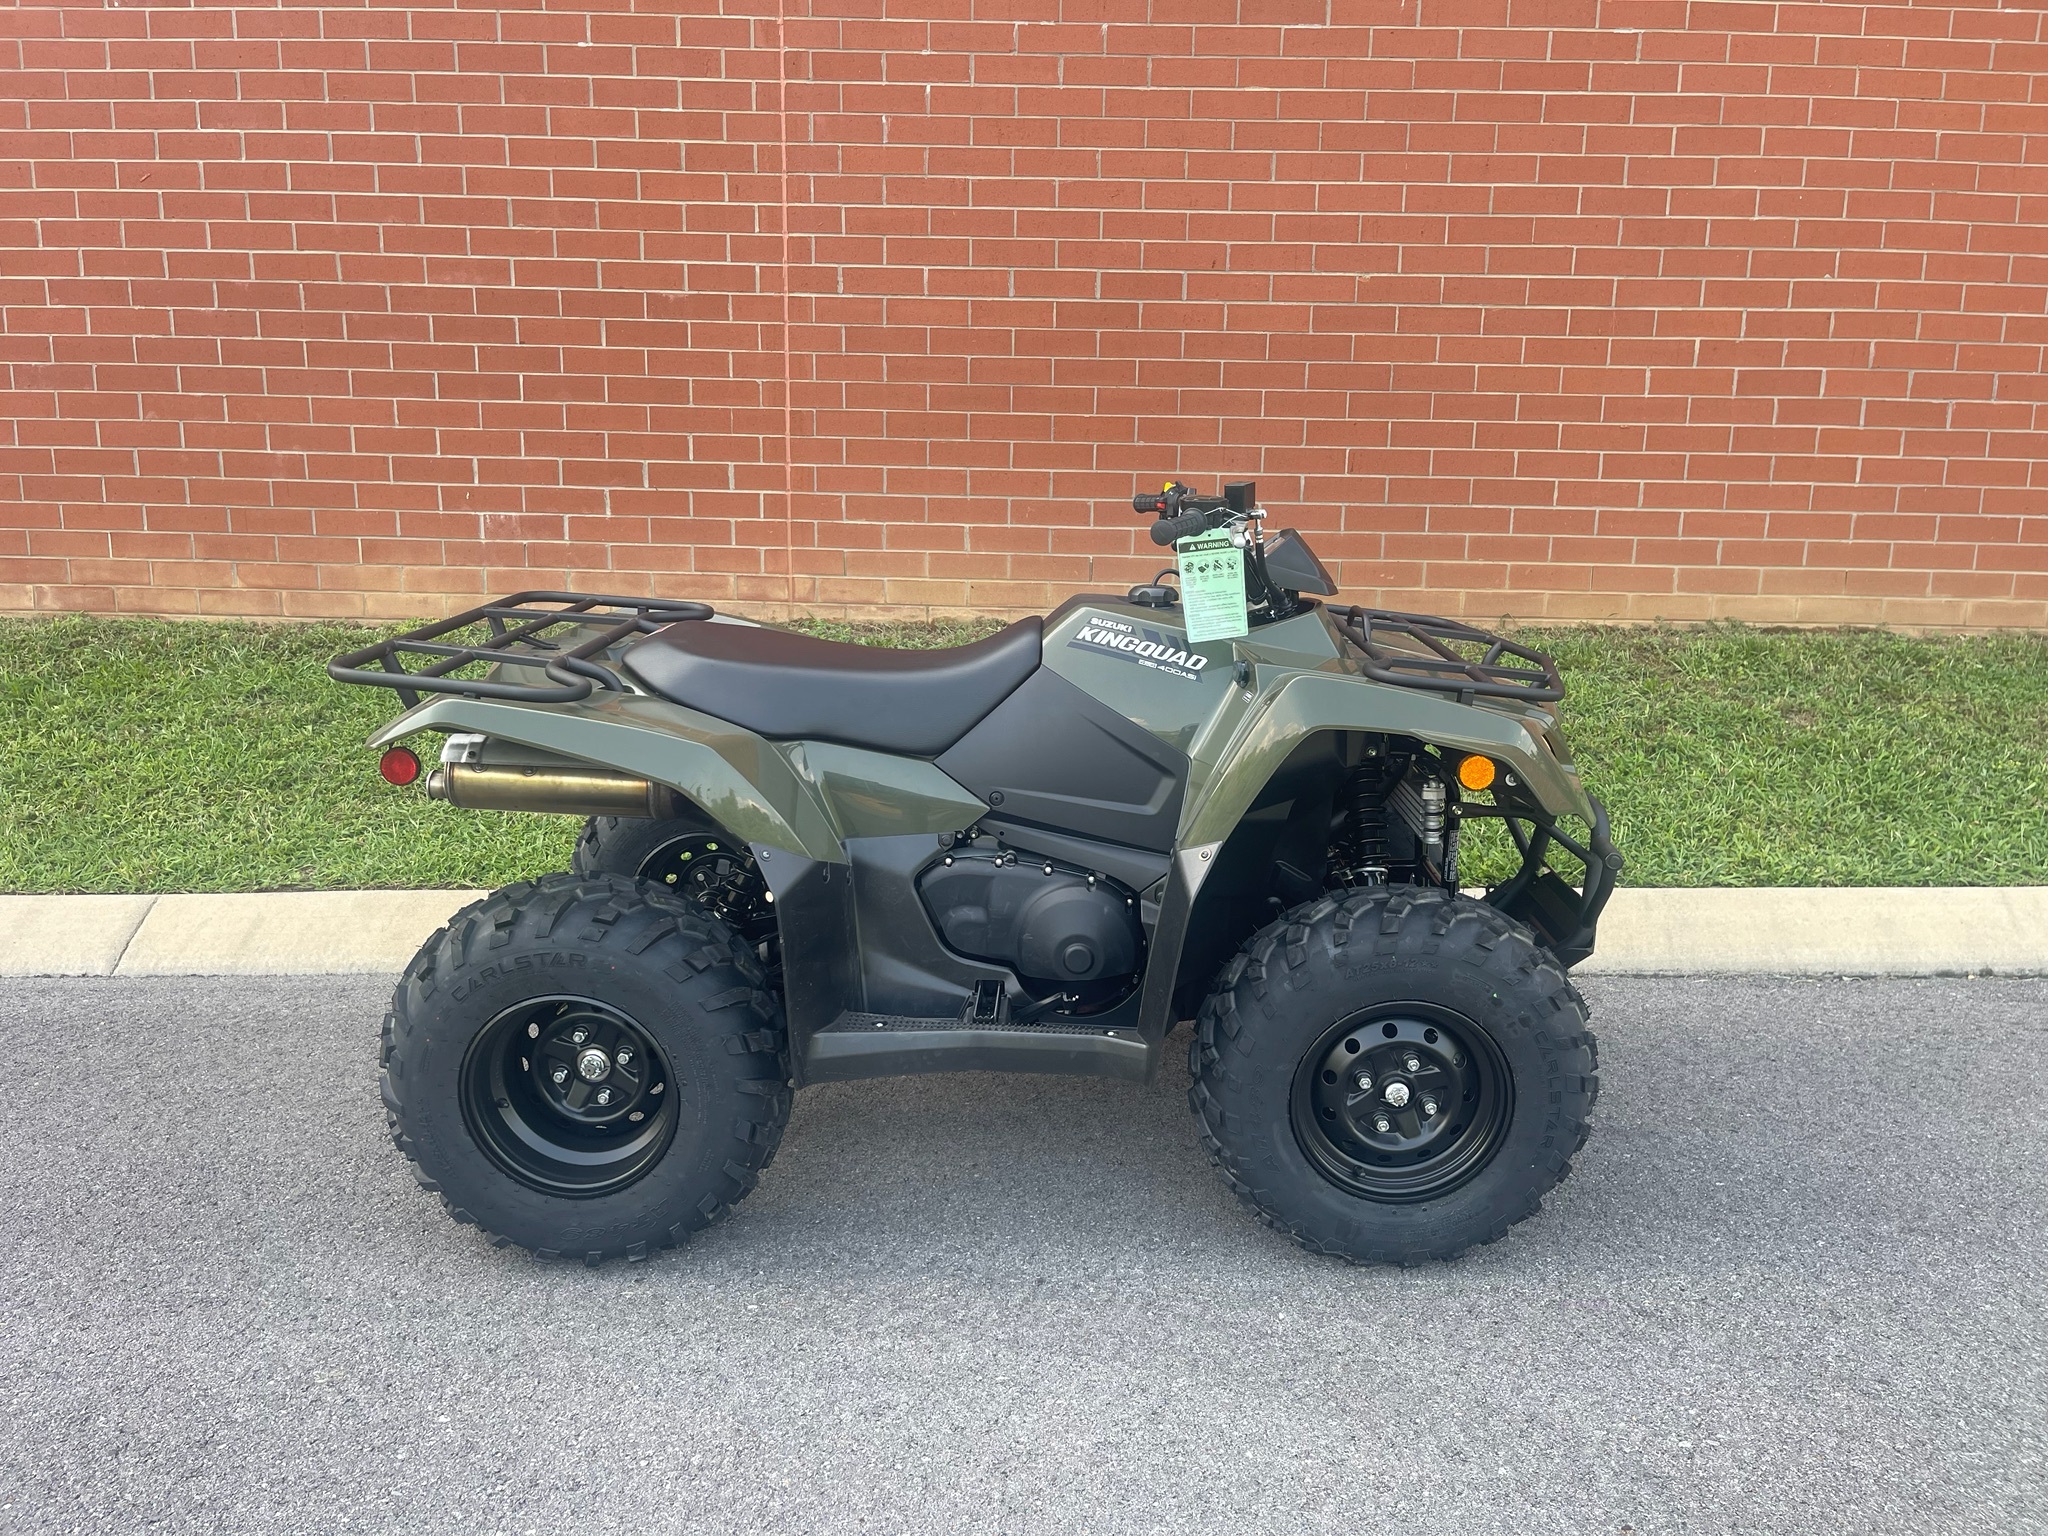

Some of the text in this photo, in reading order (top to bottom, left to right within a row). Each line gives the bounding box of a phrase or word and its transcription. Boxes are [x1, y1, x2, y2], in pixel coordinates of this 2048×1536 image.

[1197, 541, 1230, 550] WARNING
[1090, 617, 1133, 633] SUZUKI
[1076, 626, 1208, 671] KINGQUAD
[451, 952, 588, 1004] CARLSTAR
[1535, 1030, 1562, 1149] CARLSTAR
